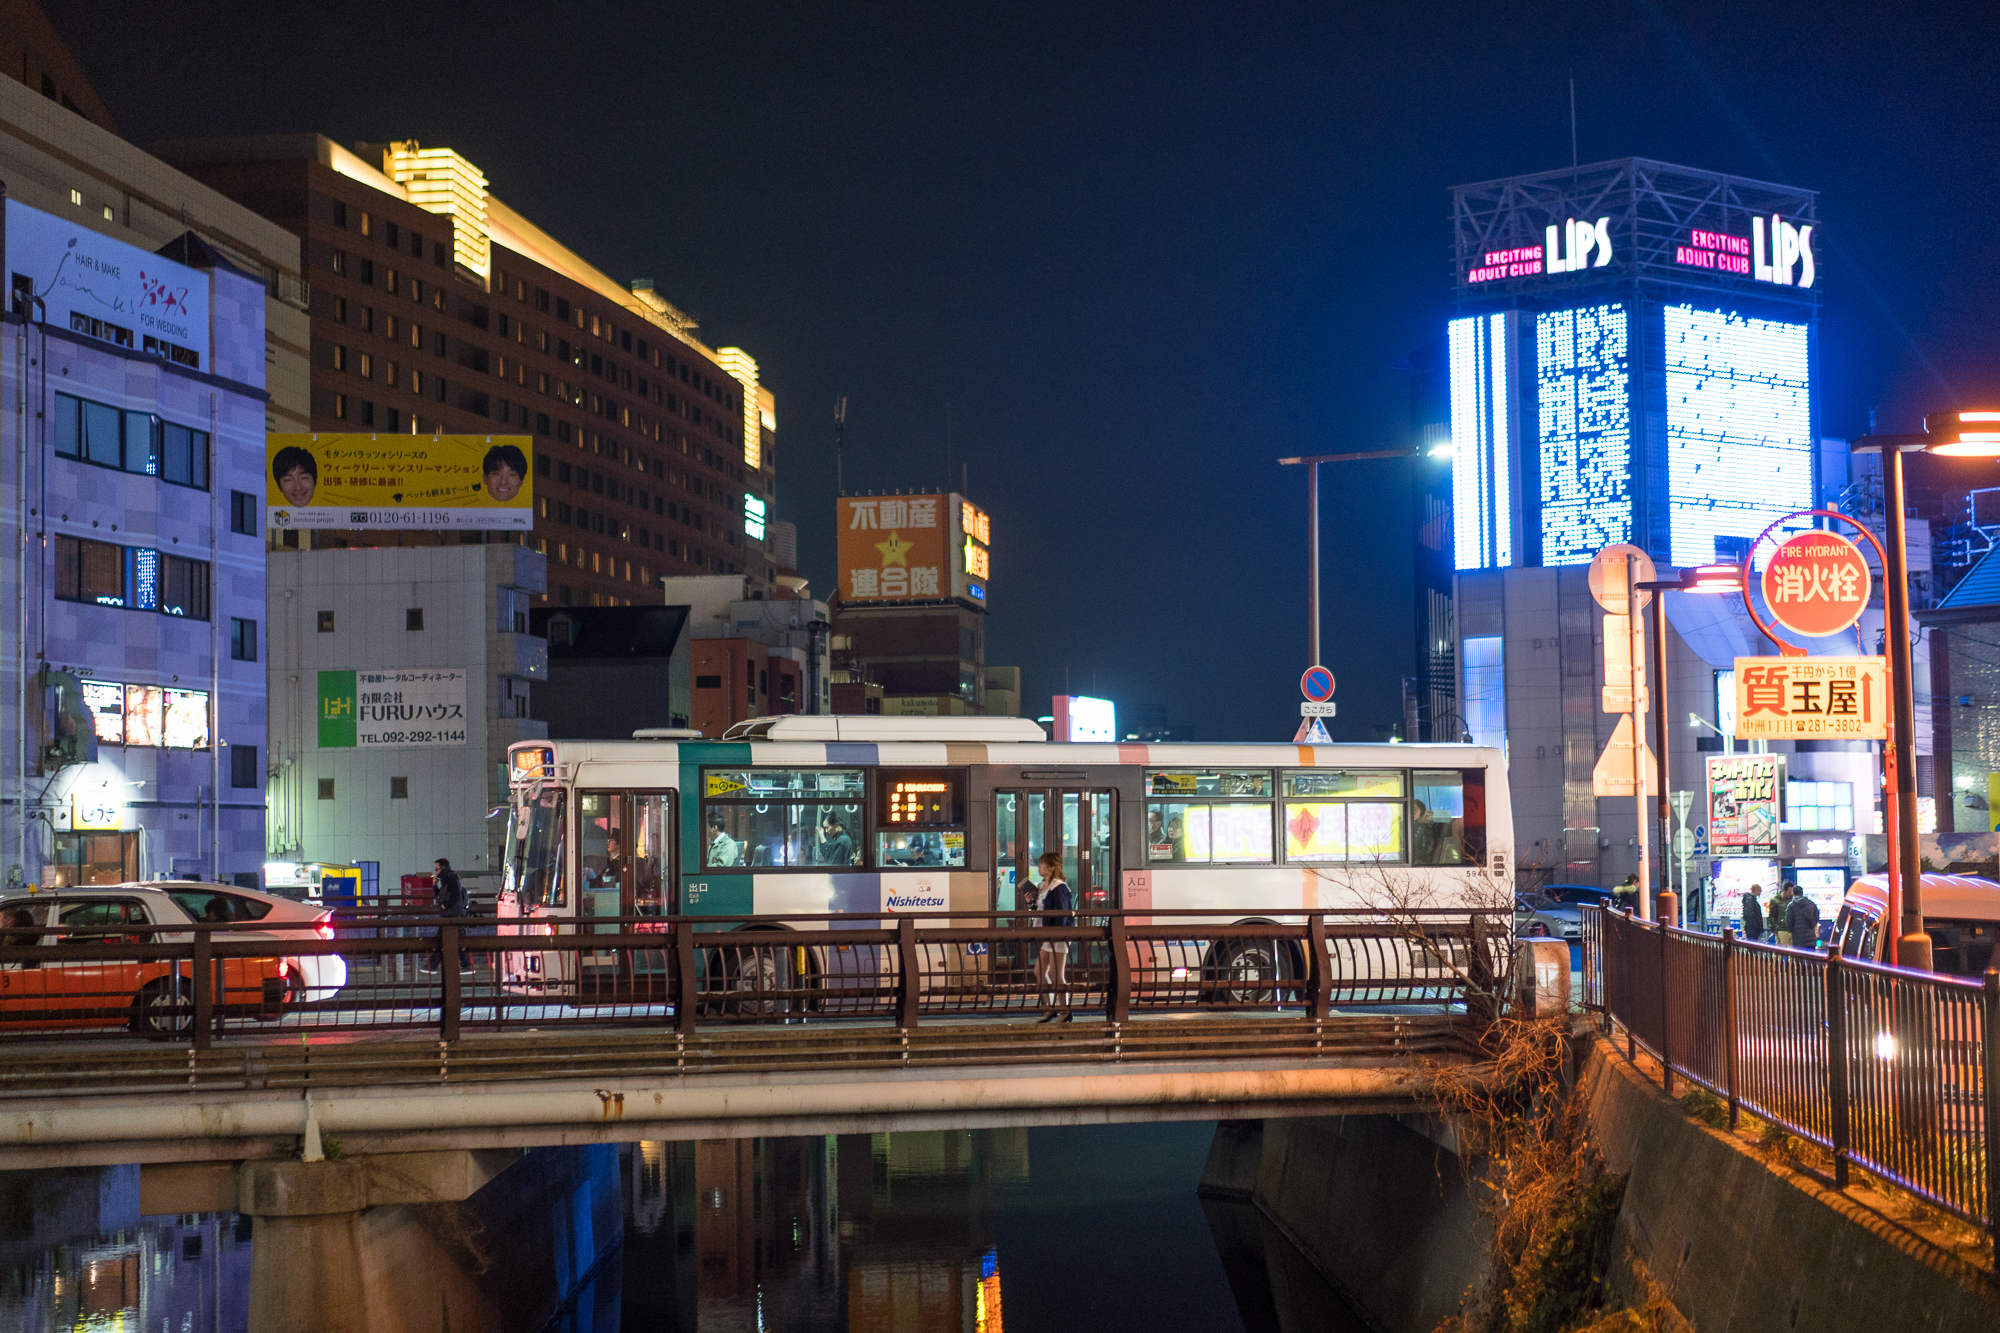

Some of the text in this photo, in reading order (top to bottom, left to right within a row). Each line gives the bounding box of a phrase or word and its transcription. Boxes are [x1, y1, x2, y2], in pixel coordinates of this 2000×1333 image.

[1546, 216, 1613, 275] LIPS
[1691, 229, 1750, 256] EXCITING
[1753, 213, 1814, 289] LIPS
[75, 252, 121, 280] HAIR & MAKE
[1484, 245, 1543, 267] EXCITING
[1676, 246, 1750, 275] ADULT CLUB
[1468, 259, 1543, 284] ADULT CLUB
[141, 313, 188, 340] FOR WEDDING
[369, 511, 450, 525] 0120-61-1196
[850, 499, 936, 530] 不動産
[1781, 545, 1850, 558] FIRE HYDRANT
[850, 567, 939, 597] 連合隊
[1774, 563, 1860, 603] 消火栓
[359, 673, 463, 684] 不動産トータルコーディネーター
[1792, 666, 1857, 679] 千円から1億
[360, 691, 404, 704] 有限会社
[1742, 665, 1858, 717] 質 玉屋
[360, 703, 464, 721] FURUハウス
[1303, 706, 1333, 714] ここから
[1808, 719, 1862, 733] 281-3802
[1711, 759, 1775, 781] ネットカフェ
[1735, 777, 1775, 801] ポパイ
[688, 883, 708, 893] 出口
[1127, 877, 1146, 887] 入口
[886, 895, 945, 908] Nishitetsu
